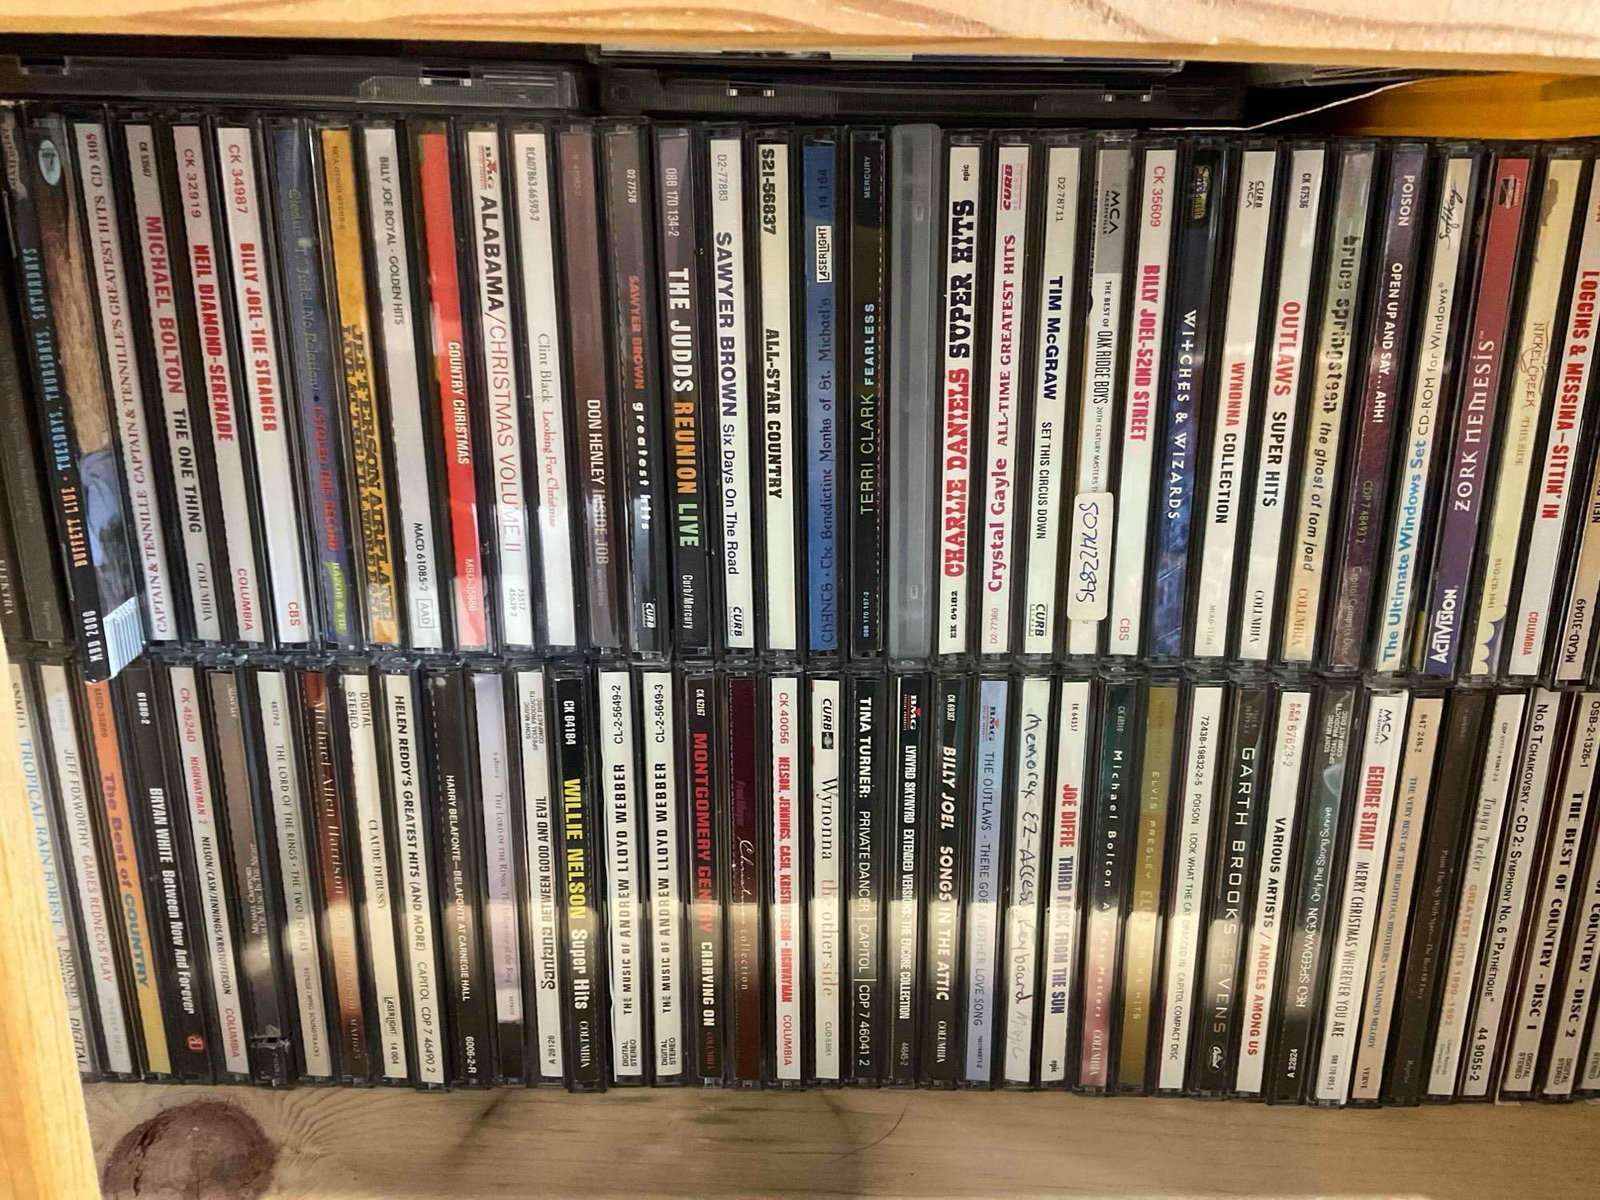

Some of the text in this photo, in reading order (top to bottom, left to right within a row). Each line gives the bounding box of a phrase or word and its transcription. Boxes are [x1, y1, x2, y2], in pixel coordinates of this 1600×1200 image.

[229, 144, 248, 214] CK 34987
[1398, 175, 1415, 226] POISON
[85, 133, 136, 404] TENNILLE'S GREATEST HITS CD 3105
[380, 156, 404, 325] BILLY JOE ROYAL GOLDEN HITS
[948, 200, 974, 358] SUPER HITS
[145, 216, 184, 393] MICHAEL BOLTON
[193, 245, 233, 441] NEIL DIAMOND-SERENADE
[241, 243, 258, 281] BILLY
[253, 360, 277, 431] STRANGER
[629, 275, 644, 389] SAWYER BROWN
[668, 268, 694, 392] THE JUDDS
[717, 232, 737, 417] SAWYER BROWN
[864, 304, 874, 386] FEARLESS
[1043, 276, 1063, 400] TIM McGRAW
[1382, 263, 1403, 349] OPEN UP AND
[1572, 271, 1599, 339] LOGGINS
[1093, 330, 1112, 404] OAK RIDGE BOYS
[1130, 265, 1160, 441] BILLY JOEL-52ND STREET
[449, 342, 469, 464] COUNTRY CHRISTMAS
[587, 400, 605, 485] DON HENLEY
[766, 329, 782, 499] ALL-STAR COUNTRY
[1168, 309, 1197, 519] WITCHES WIZARDS
[1215, 362, 1245, 524] WYNONNA COLLECTION
[1263, 302, 1301, 507] OUTLAWS SUPER HITS
[172, 409, 202, 533] THE ONE THING
[673, 401, 698, 546] REUNION LIVE
[860, 394, 873, 515] TERRI CLARK
[944, 368, 970, 577] CHARLIE DANIELS
[1036, 422, 1052, 539] SET THIS CIRCUS DOWN
[723, 424, 739, 575] Six Days On The Road
[988, 459, 1008, 592] Crystal Gayle
[1383, 440, 1427, 661] The Ultimate Windows Set
[237, 568, 253, 631] COLUMBIA
[1119, 618, 1130, 641] CBS
[1522, 612, 1538, 656] COLUMBIA
[1565, 599, 1586, 664] MCAD-31049
[347, 692, 359, 729] STEREO
[359, 692, 371, 728] DIGITAL
[612, 685, 623, 744] CL-2-5649-2
[654, 684, 665, 743] CL-2-5649-3
[822, 698, 832, 730] CURB
[859, 697, 871, 798] TINA TURNER:
[1194, 716, 1209, 786] 72438-19832-2-5
[64, 749, 90, 848] JEFF FOXWORTHY
[394, 696, 419, 878] HELEN REDDY'S GREATEST HITS
[693, 733, 711, 861] MONTGOMERY
[904, 745, 917, 823] LYNYRD SKYNYRD
[940, 746, 956, 830] BILLY JOEL
[981, 752, 994, 831] THE OUTLAWS
[1020, 714, 1042, 799] Memorex
[1235, 747, 1255, 825] GARTH
[149, 788, 172, 863] BRYAN WHITE
[564, 779, 586, 919] WILLIE NELSON
[816, 778, 837, 860] Wynonna
[859, 811, 870, 859] PRIVATE
[1059, 784, 1078, 848] JOE DIFFIE
[1104, 750, 1123, 887] Michael Bolton
[1357, 766, 1385, 851] GEORGE STRAIT
[1472, 798, 1497, 872] Tanya Tucker
[1514, 815, 1528, 833] CD
[1559, 791, 1584, 868] THE BEST
[446, 775, 470, 1001] HARRY HALL
[1223, 841, 1246, 935] BROOKS
[1263, 818, 1286, 928] VARIOUS ARTISTS
[1345, 861, 1369, 947] MERRY CHRISTMAS
[124, 893, 148, 987] COUNTRY
[161, 870, 196, 1014] Between Now And Forever
[859, 924, 869, 973] CAPITOL
[1539, 899, 1562, 968] COUNTRY
[701, 942, 715, 1026] CARRYING ON
[859, 985, 869, 1008] CDP
[1529, 984, 1546, 1017] DISC
[225, 1008, 240, 1058] COLUMBIA
[783, 1015, 792, 1065] COLUMBIA
[859, 1021, 869, 1055] 46041
[1469, 1028, 1488, 1082] 44 9055-2
